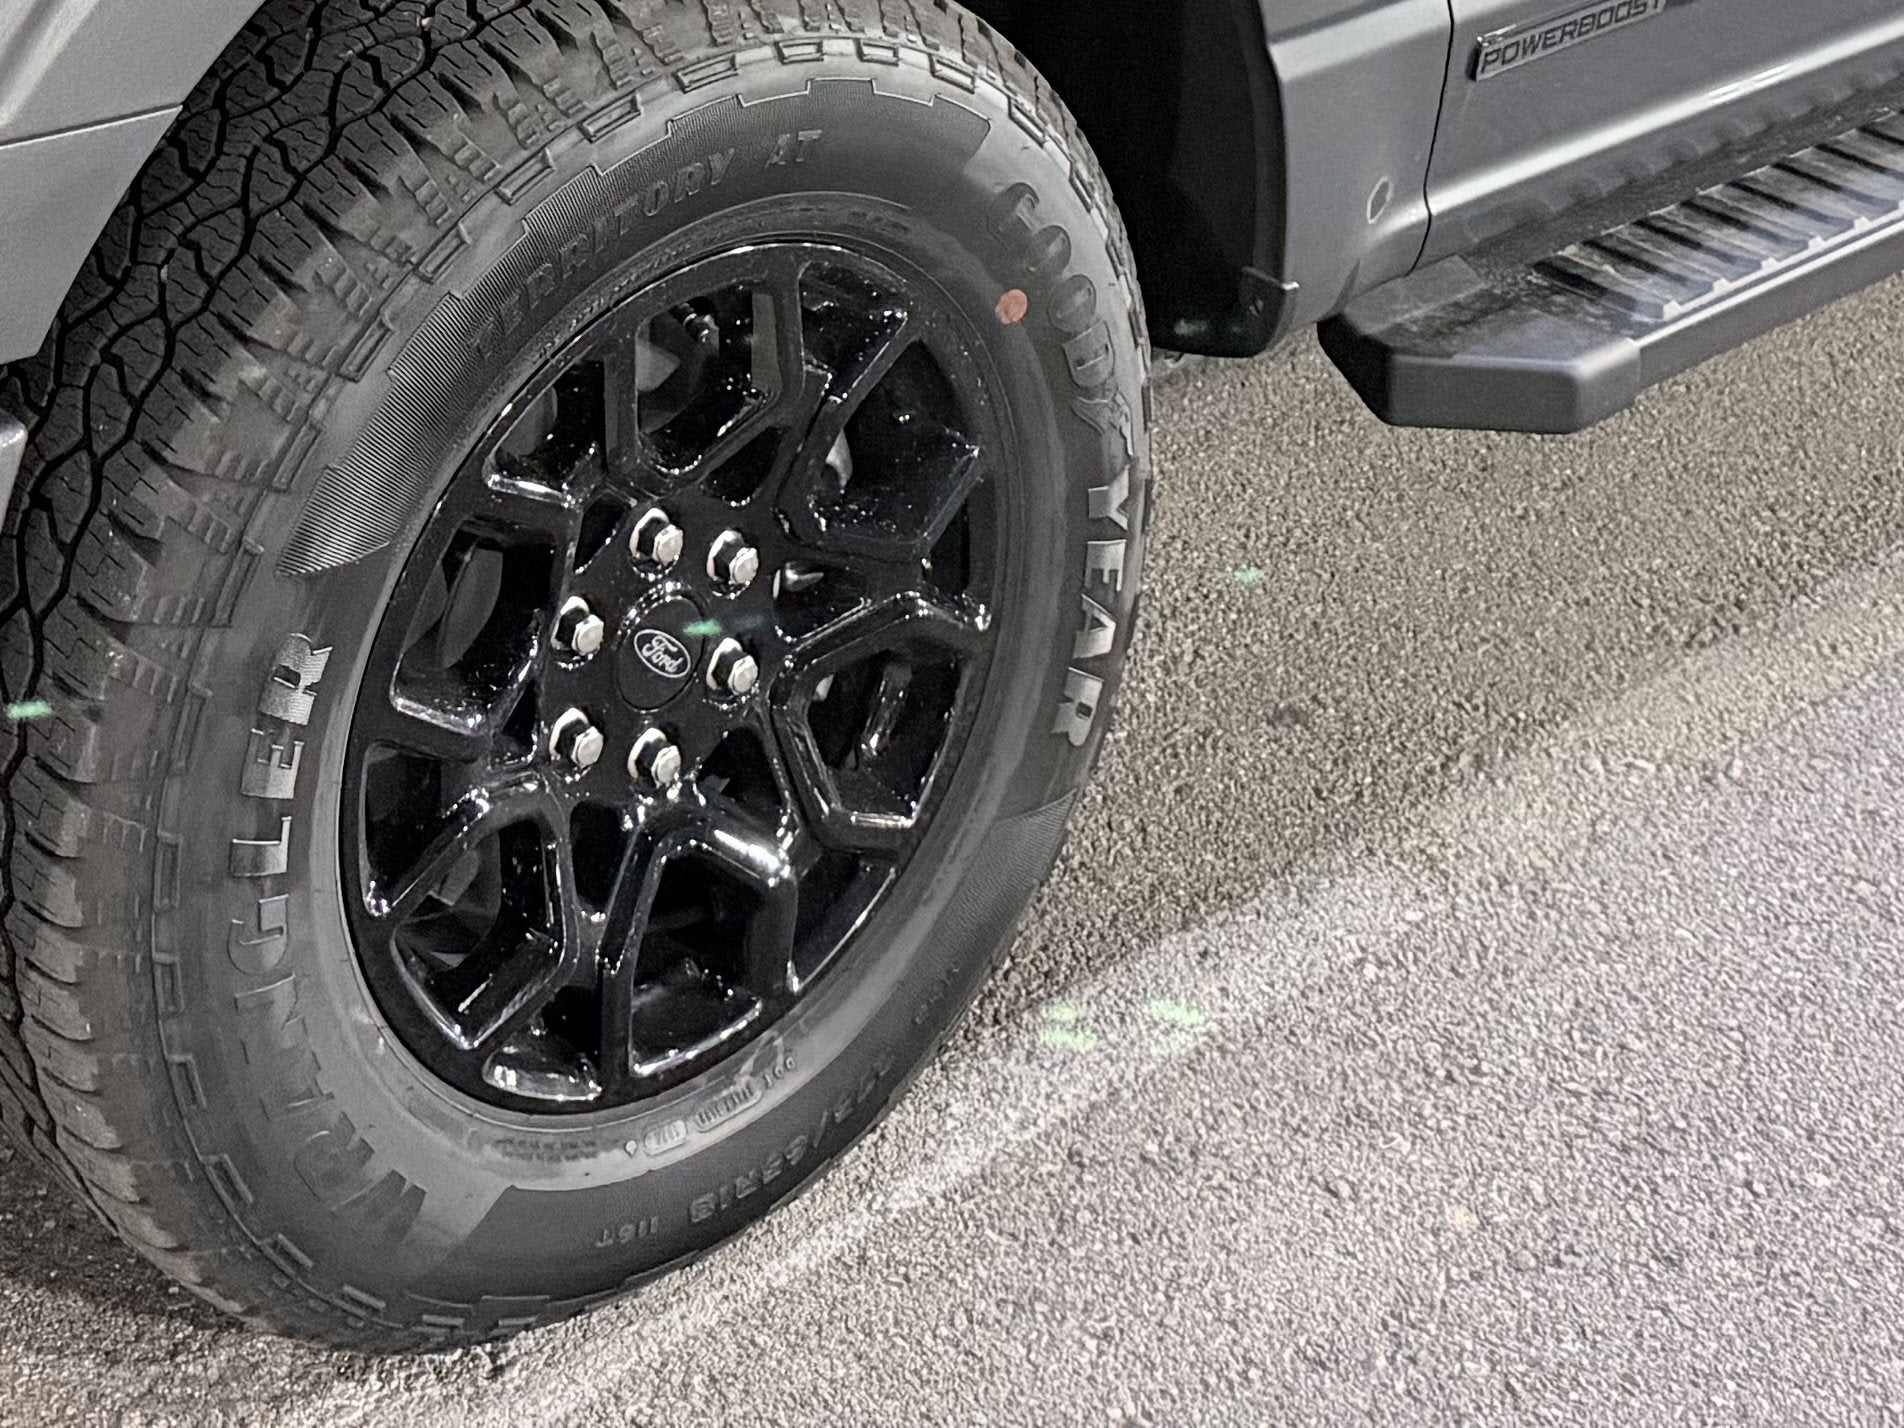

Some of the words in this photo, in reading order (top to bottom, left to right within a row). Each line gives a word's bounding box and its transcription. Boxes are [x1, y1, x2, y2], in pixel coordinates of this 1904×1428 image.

[470, 147, 736, 360] TERRITORY
[987, 181, 1133, 748] GOODYEAR
[226, 632, 428, 1250] WRANGLER
